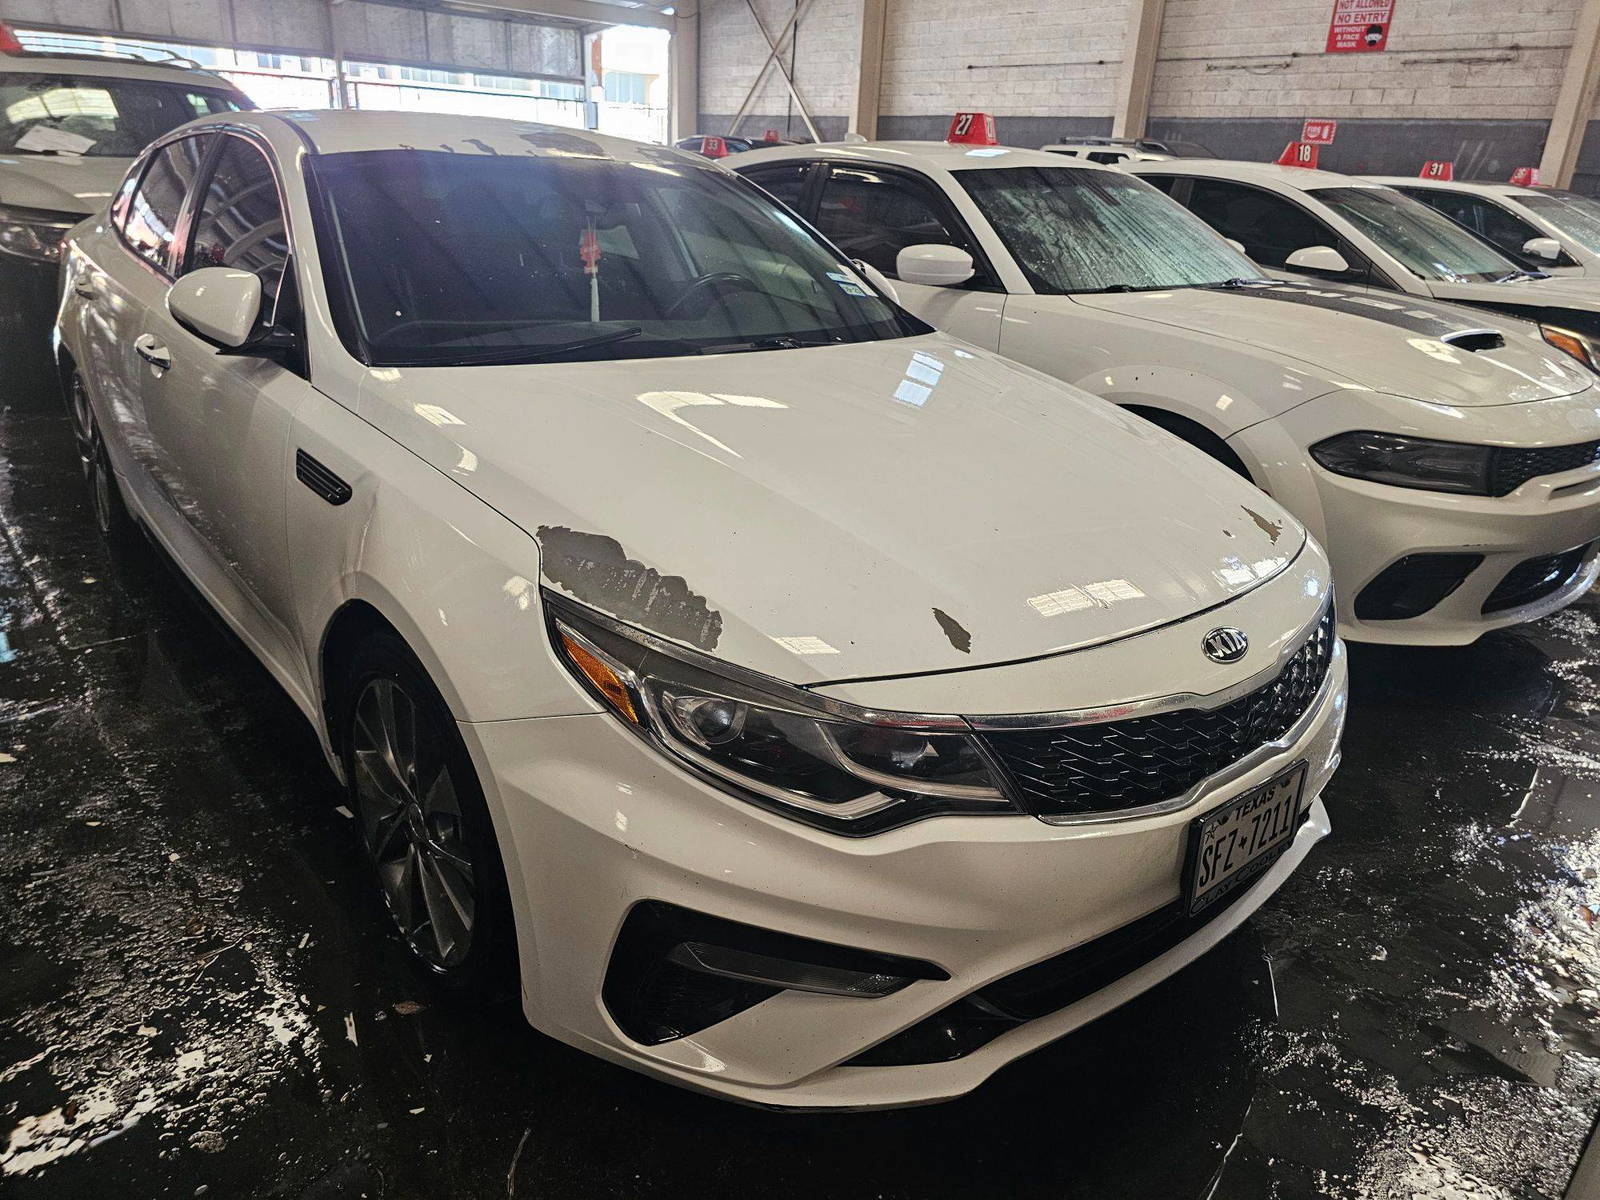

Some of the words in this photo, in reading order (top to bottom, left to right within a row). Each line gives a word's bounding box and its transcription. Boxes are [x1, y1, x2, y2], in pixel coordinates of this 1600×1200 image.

[1337, 13, 1352, 23] NO
[1354, 12, 1386, 22] ENTRY
[955, 114, 973, 135] 27
[1299, 144, 1311, 162] 18
[1430, 162, 1443, 176] 31
[1208, 629, 1247, 658] KIA
[1235, 786, 1276, 821] TEXAS
